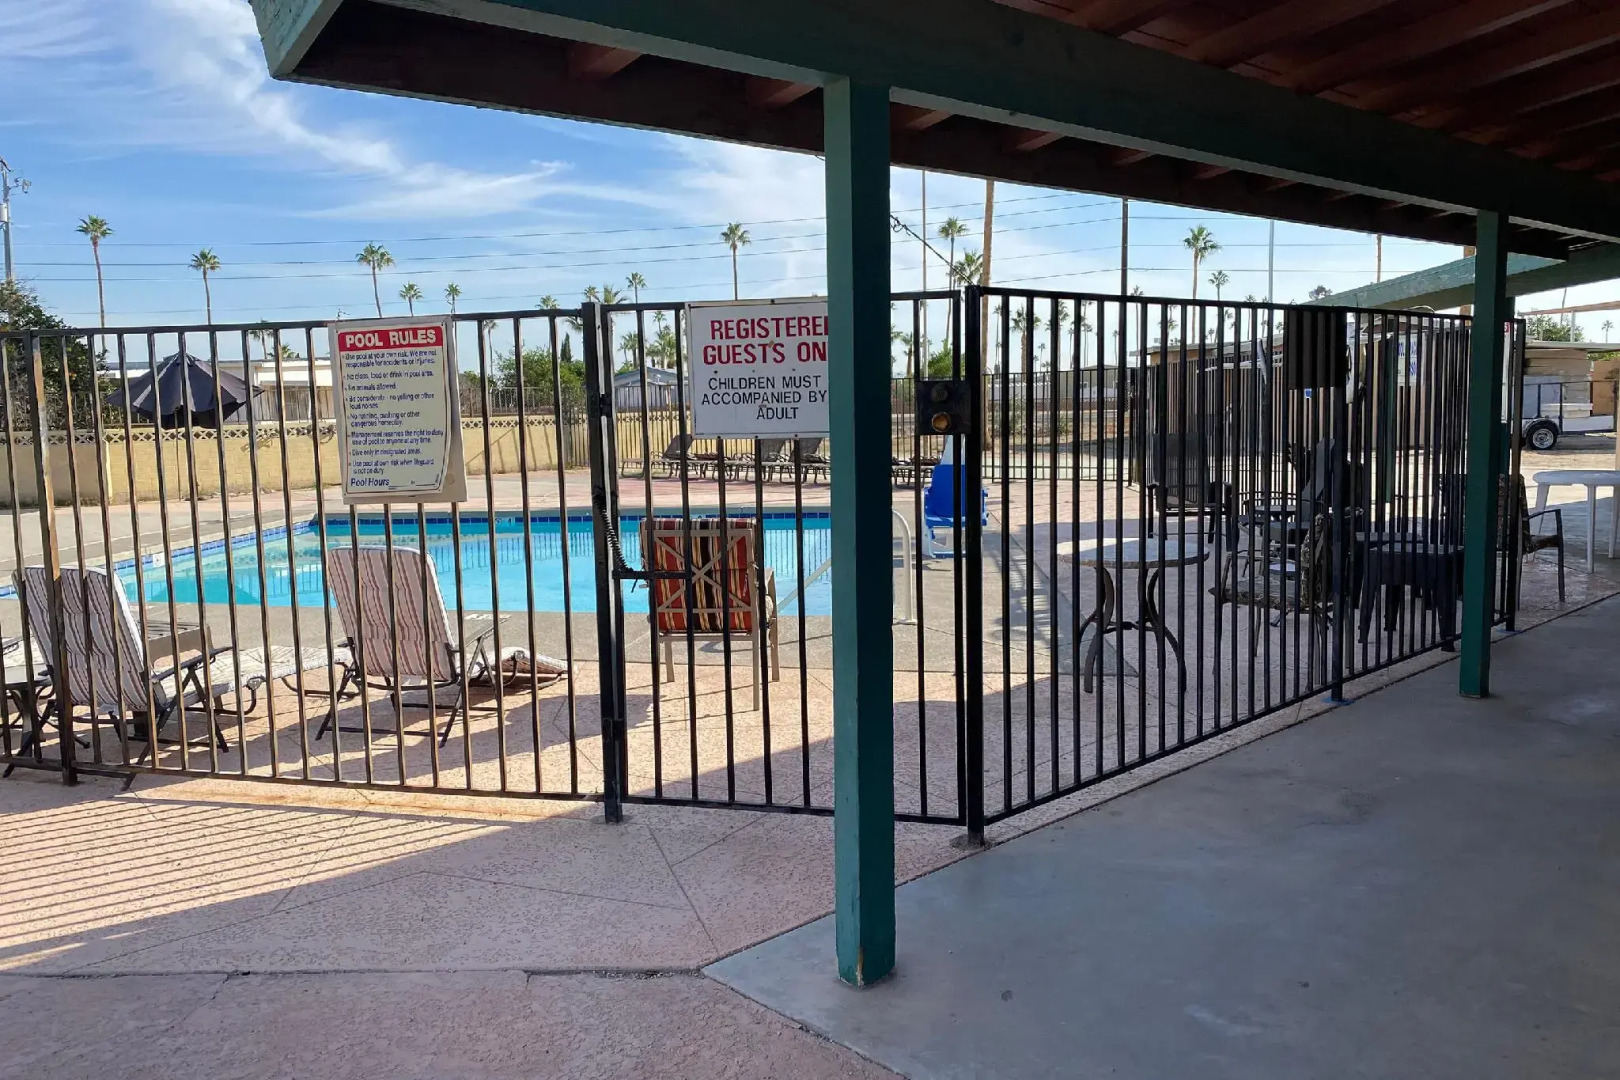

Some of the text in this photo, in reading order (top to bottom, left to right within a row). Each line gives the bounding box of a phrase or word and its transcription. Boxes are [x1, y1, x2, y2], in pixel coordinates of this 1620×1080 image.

[346, 329, 436, 348] POOL RULES
[703, 342, 826, 365] GUESTS ON
[708, 375, 821, 390] CHILDREN MUST
[702, 390, 827, 405] ACCOMPANIED BY
[756, 407, 798, 420] ADULT
[351, 478, 366, 486] Pool
[368, 478, 389, 486] Hours
